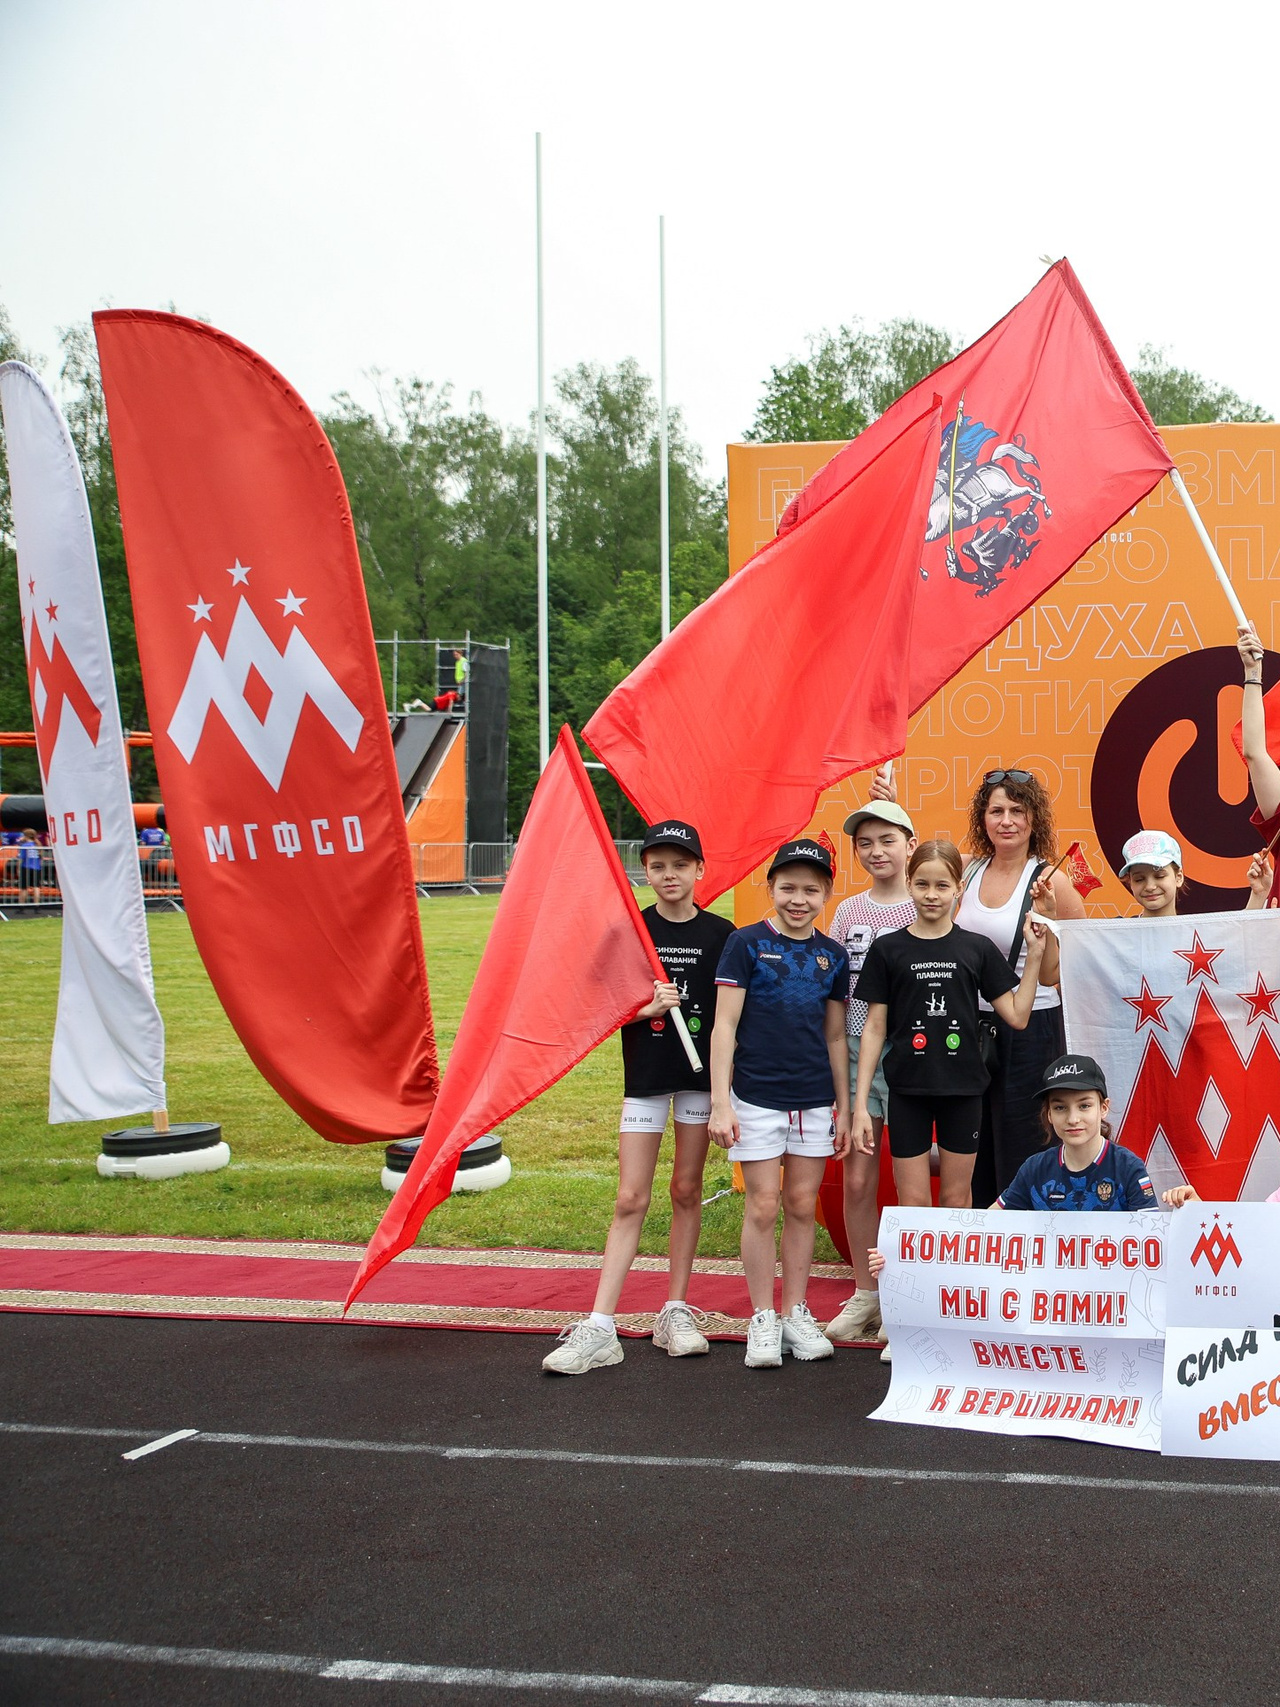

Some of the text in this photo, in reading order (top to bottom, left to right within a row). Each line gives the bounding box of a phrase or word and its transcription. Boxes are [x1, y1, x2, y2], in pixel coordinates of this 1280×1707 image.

[1098, 532, 1132, 544] ГФСО
[985, 601, 1205, 672] ДУХА
[202, 815, 365, 863] МГФСО
[910, 961, 957, 971] СИНХРОННОЕ
[916, 971, 953, 980] ПЛАВАНИЕ
[898, 1228, 1163, 1275] КОМАНДА МГФСО
[938, 1284, 1129, 1327] МЫ С ВАМИ!
[1194, 1284, 1237, 1297] МГФСО
[969, 1338, 1090, 1374] ВМЕСТЕ
[1176, 1324, 1259, 1387] СИЛА
[925, 1385, 1143, 1429] К ВЕРШИНАМ!
